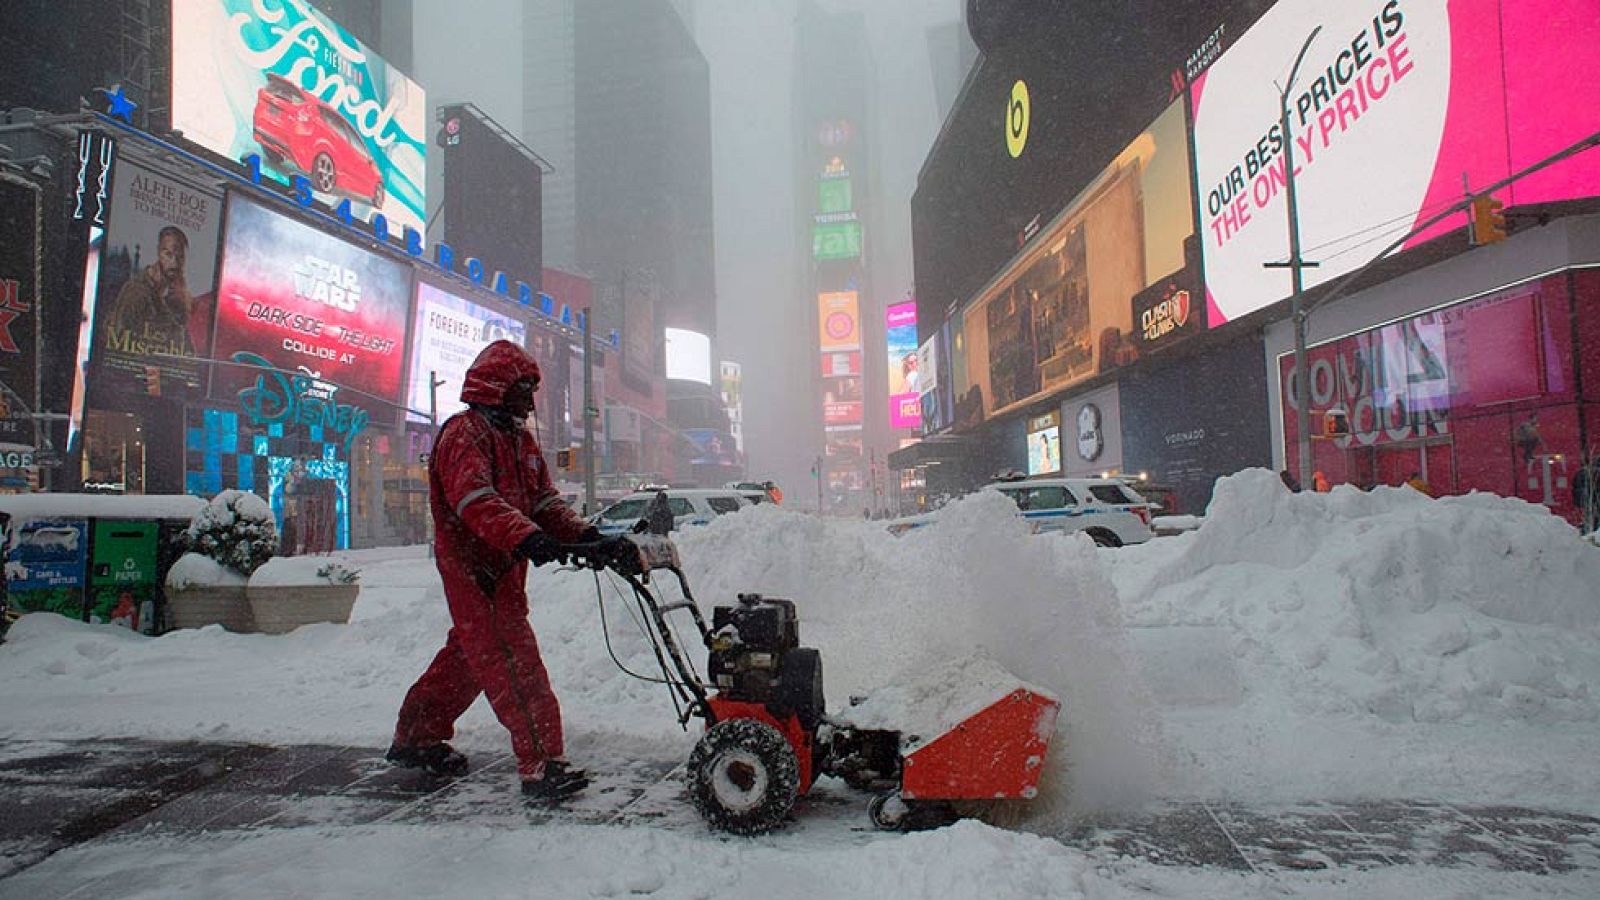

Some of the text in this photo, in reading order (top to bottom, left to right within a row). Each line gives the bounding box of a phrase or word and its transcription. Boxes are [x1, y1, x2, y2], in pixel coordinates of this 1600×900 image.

[1186, 23, 1225, 67] MARRIOTT
[1187, 44, 1222, 80] MARQUIS
[228, 0, 402, 148] Ford
[1207, 0, 1404, 216] OUR BES PRICE IS
[1211, 192, 1252, 247] THE
[1318, 33, 1414, 148] PRICE
[131, 174, 208, 213] ALFIE BOE
[134, 199, 149, 213] TO
[242, 153, 389, 244] 1540
[293, 255, 362, 294] STAR
[293, 274, 361, 312] WARS
[247, 302, 395, 355] DARK SIDE THE LIGHT
[430, 311, 470, 338] FOREVER
[282, 338, 356, 365] COLLIDE AT
[116, 571, 142, 581] PAPER
